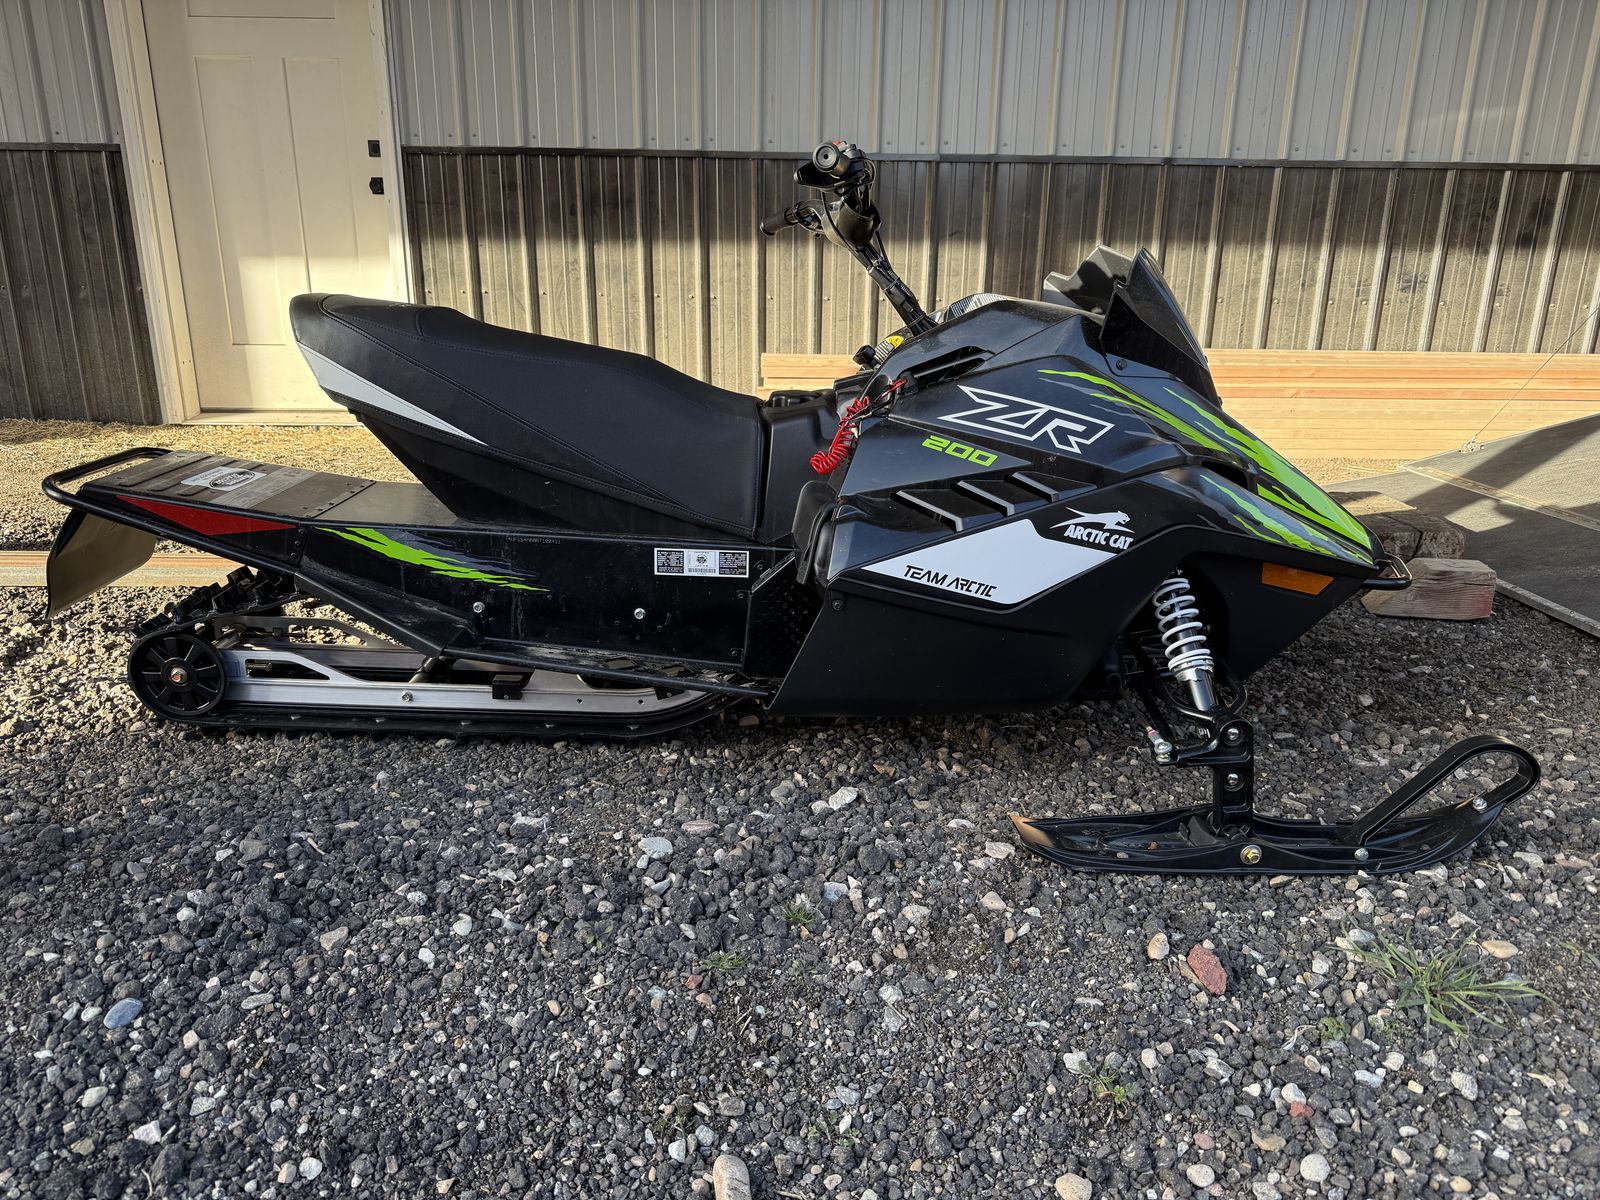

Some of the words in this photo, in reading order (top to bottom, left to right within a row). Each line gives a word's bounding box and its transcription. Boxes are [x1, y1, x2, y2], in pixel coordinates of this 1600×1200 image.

[937, 385, 1115, 454] ZR
[922, 436, 999, 467] 200
[1064, 525, 1109, 546] ARCTIC
[1109, 535, 1134, 550] CAT
[903, 565, 948, 586] TEAM
[948, 577, 997, 598] ARCTIC
